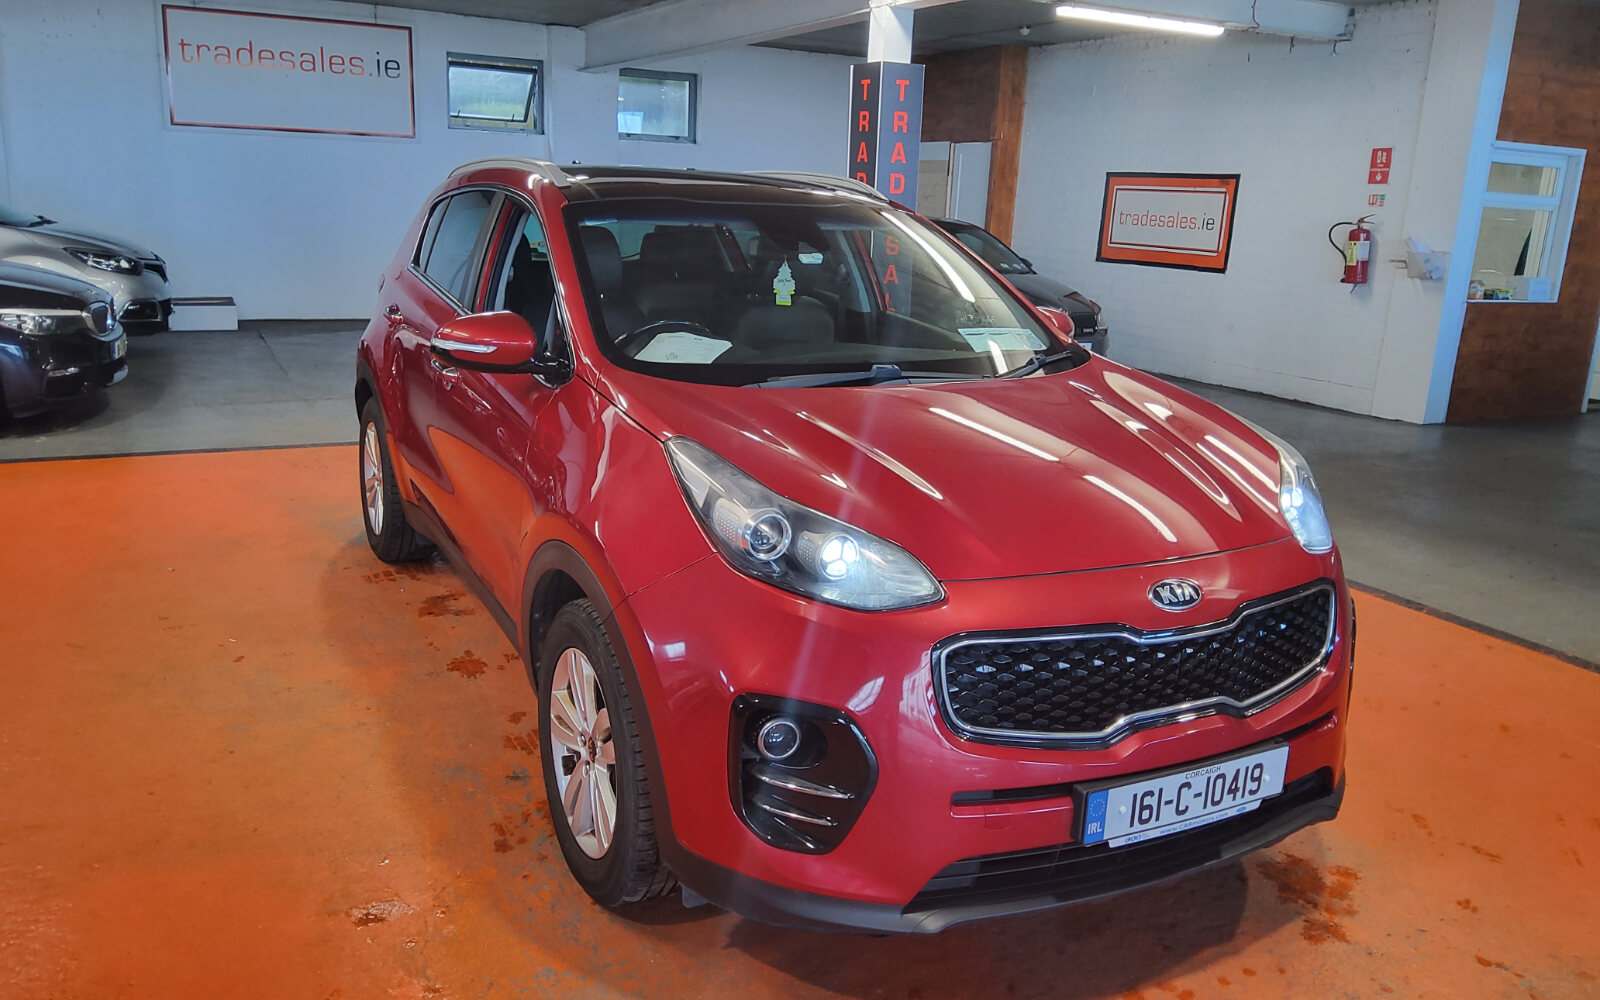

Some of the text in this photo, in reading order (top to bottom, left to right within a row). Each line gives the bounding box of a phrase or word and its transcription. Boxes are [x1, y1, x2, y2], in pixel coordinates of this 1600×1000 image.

[178, 38, 401, 79] tradesales.ie
[1119, 210, 1215, 231] tradesales.ie
[1156, 583, 1199, 604] KIA
[1185, 765, 1221, 780] CORCAIGH
[1129, 762, 1264, 829] 161-C-10419
[1087, 821, 1103, 835] IRL
